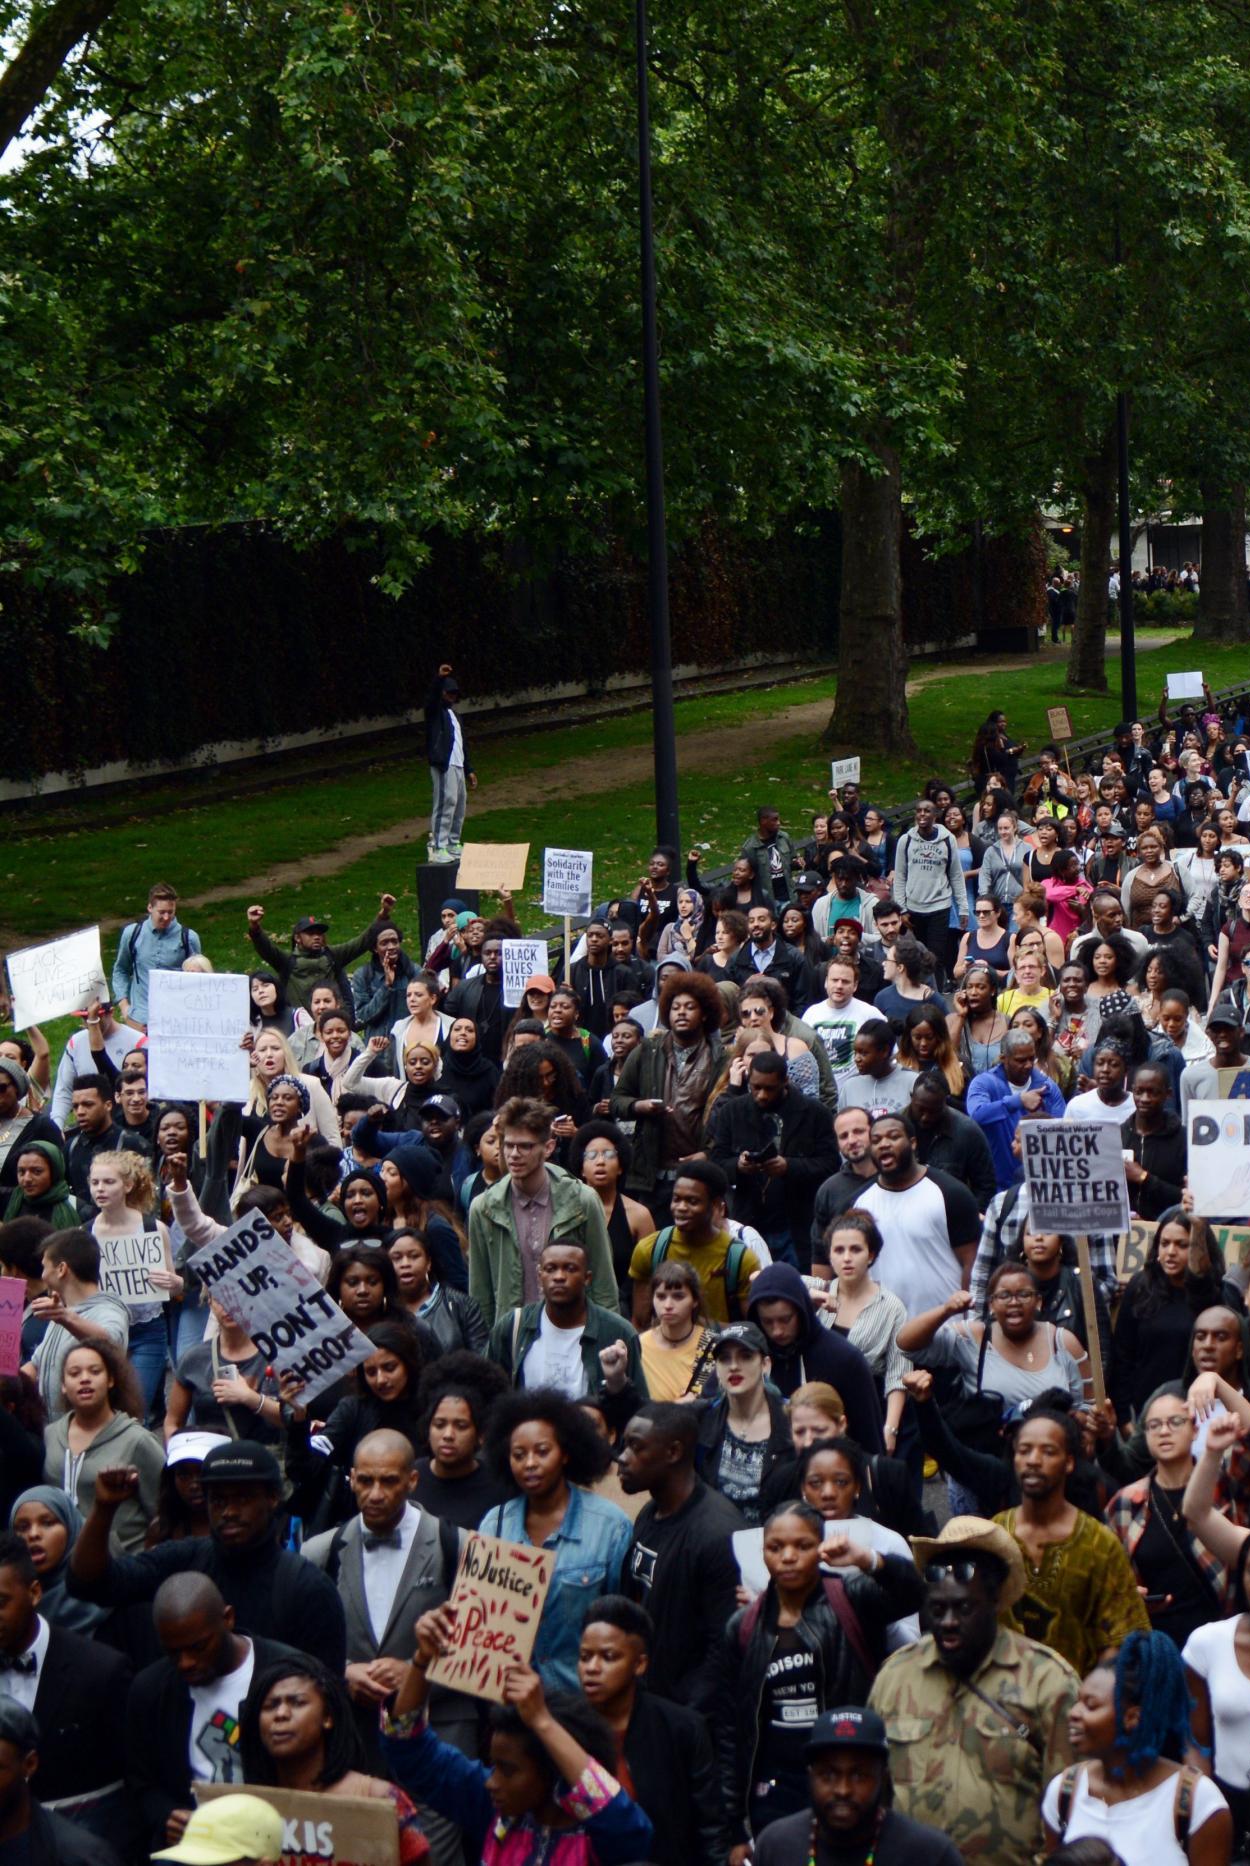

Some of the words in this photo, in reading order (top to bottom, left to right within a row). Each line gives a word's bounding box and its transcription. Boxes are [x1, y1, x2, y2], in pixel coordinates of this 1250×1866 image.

[547, 858, 588, 872] Solidarity
[547, 869, 564, 880] with
[566, 870, 581, 881] the
[547, 880, 580, 892] families
[504, 948, 537, 961] BLACK
[505, 961, 533, 975] LIVES
[35, 970, 106, 1007] MATTER
[160, 974, 185, 991] ALL
[199, 975, 239, 992] LIVES
[160, 1016, 216, 1035] MATTER
[205, 1039, 239, 1055] LIVES
[1036, 1125, 1072, 1133] Socialist
[1073, 1125, 1104, 1133] Worker
[1025, 1134, 1100, 1156] BLACK
[1027, 1158, 1090, 1180] LIVES
[1030, 1180, 1120, 1204] MATTER
[100, 1239, 123, 1266] ACK
[123, 1236, 162, 1265] LIVES
[195, 1216, 276, 1287] HANDS
[98, 1267, 157, 1296] ATTER
[250, 1288, 336, 1362] DON'T
[460, 1541, 480, 1577] No
[478, 1551, 534, 1597] Justice
[766, 1653, 814, 1678] DISON
[772, 1684, 797, 1696] NEW
[800, 1682, 816, 1693] YO
[304, 1820, 334, 1857] IS
